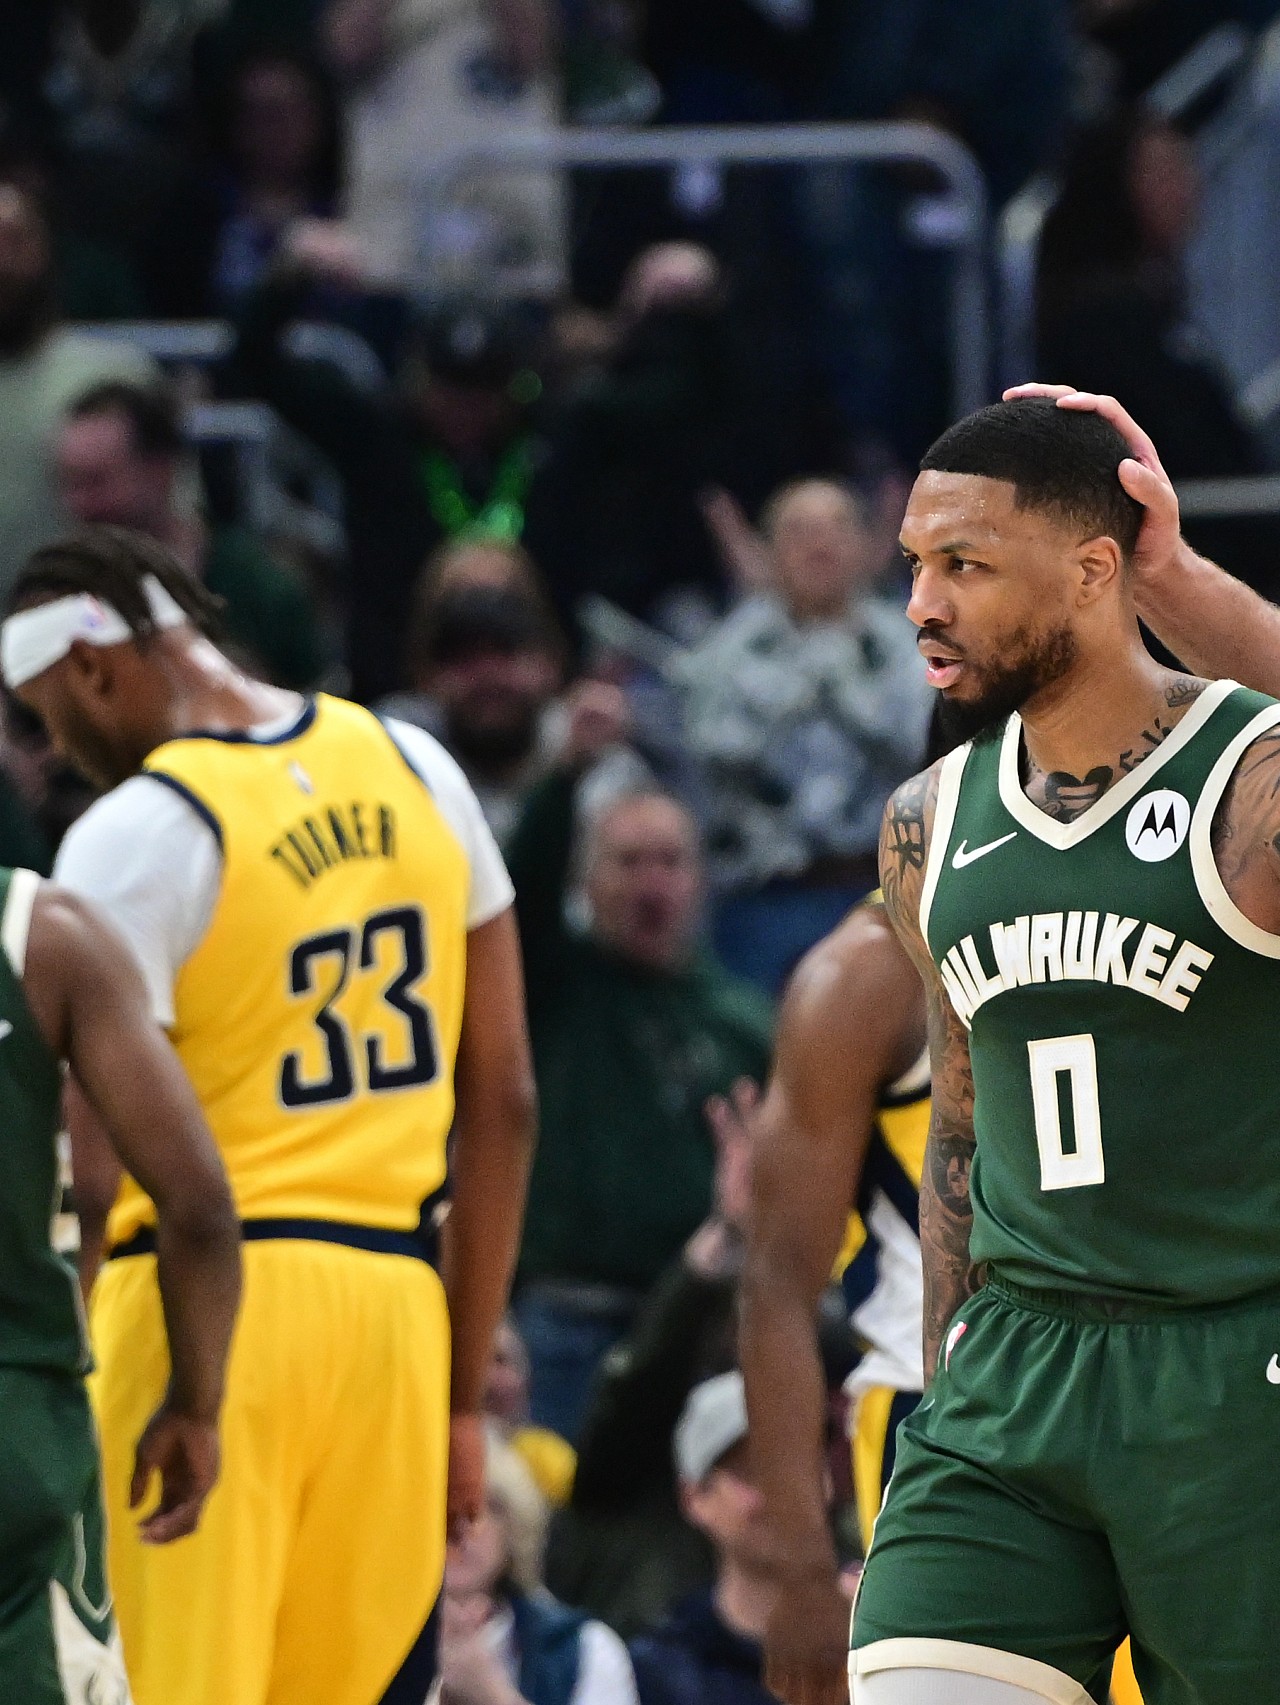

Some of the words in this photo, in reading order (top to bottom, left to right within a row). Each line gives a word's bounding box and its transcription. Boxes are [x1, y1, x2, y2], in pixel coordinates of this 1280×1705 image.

[279, 901, 439, 1109] 33
[940, 910, 1216, 1032] MILWAUKEE
[1026, 1033, 1105, 1191] 0
